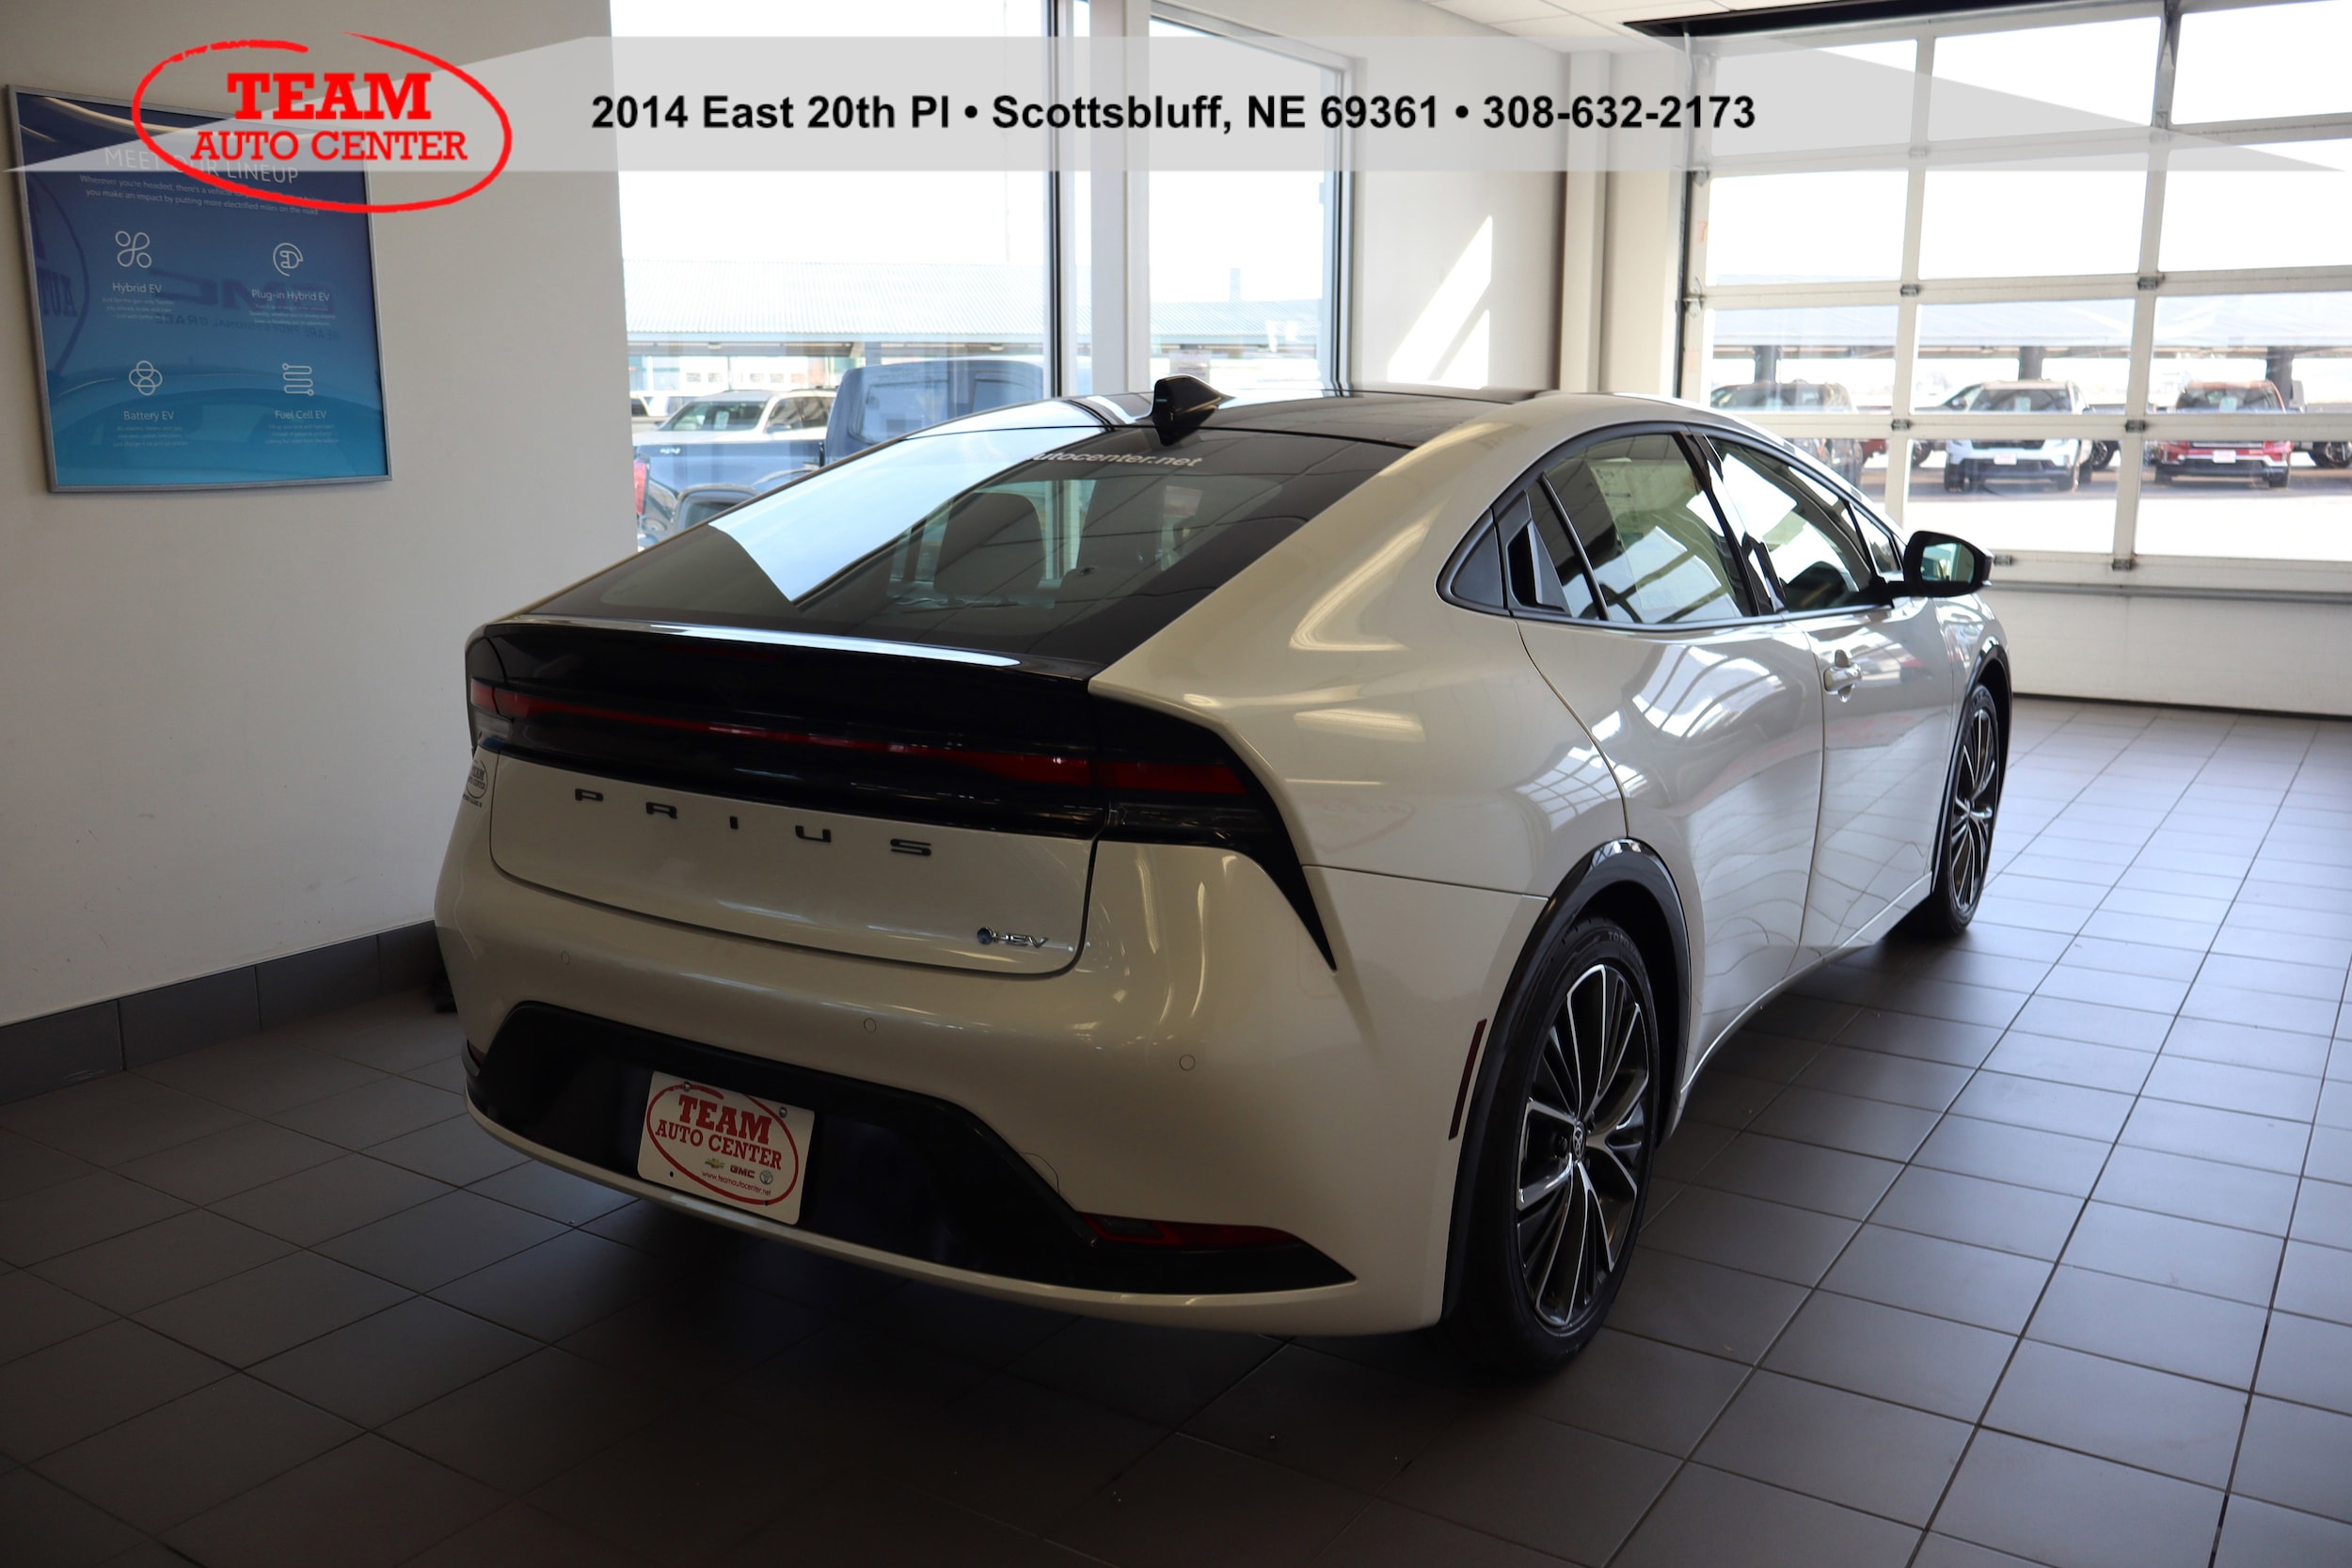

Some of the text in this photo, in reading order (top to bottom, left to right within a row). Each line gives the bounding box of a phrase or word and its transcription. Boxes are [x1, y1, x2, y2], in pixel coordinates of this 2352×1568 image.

[226, 160, 298, 183] LINEUP
[80, 175, 118, 185] Wherever
[113, 282, 162, 293] Hybrid EV
[251, 289, 330, 302] Plug-in Hybrid EV
[123, 410, 174, 422] Battery EV
[275, 409, 326, 420] Fuel Cell EV
[1029, 451, 1204, 467] utocenter.net
[574, 787, 932, 857] PRIUS
[678, 1094, 772, 1145] TEAM
[655, 1119, 783, 1170] AUTO CENTER
[729, 1164, 755, 1180] GMC
[702, 1171, 771, 1196] www.teamautocenter.net
